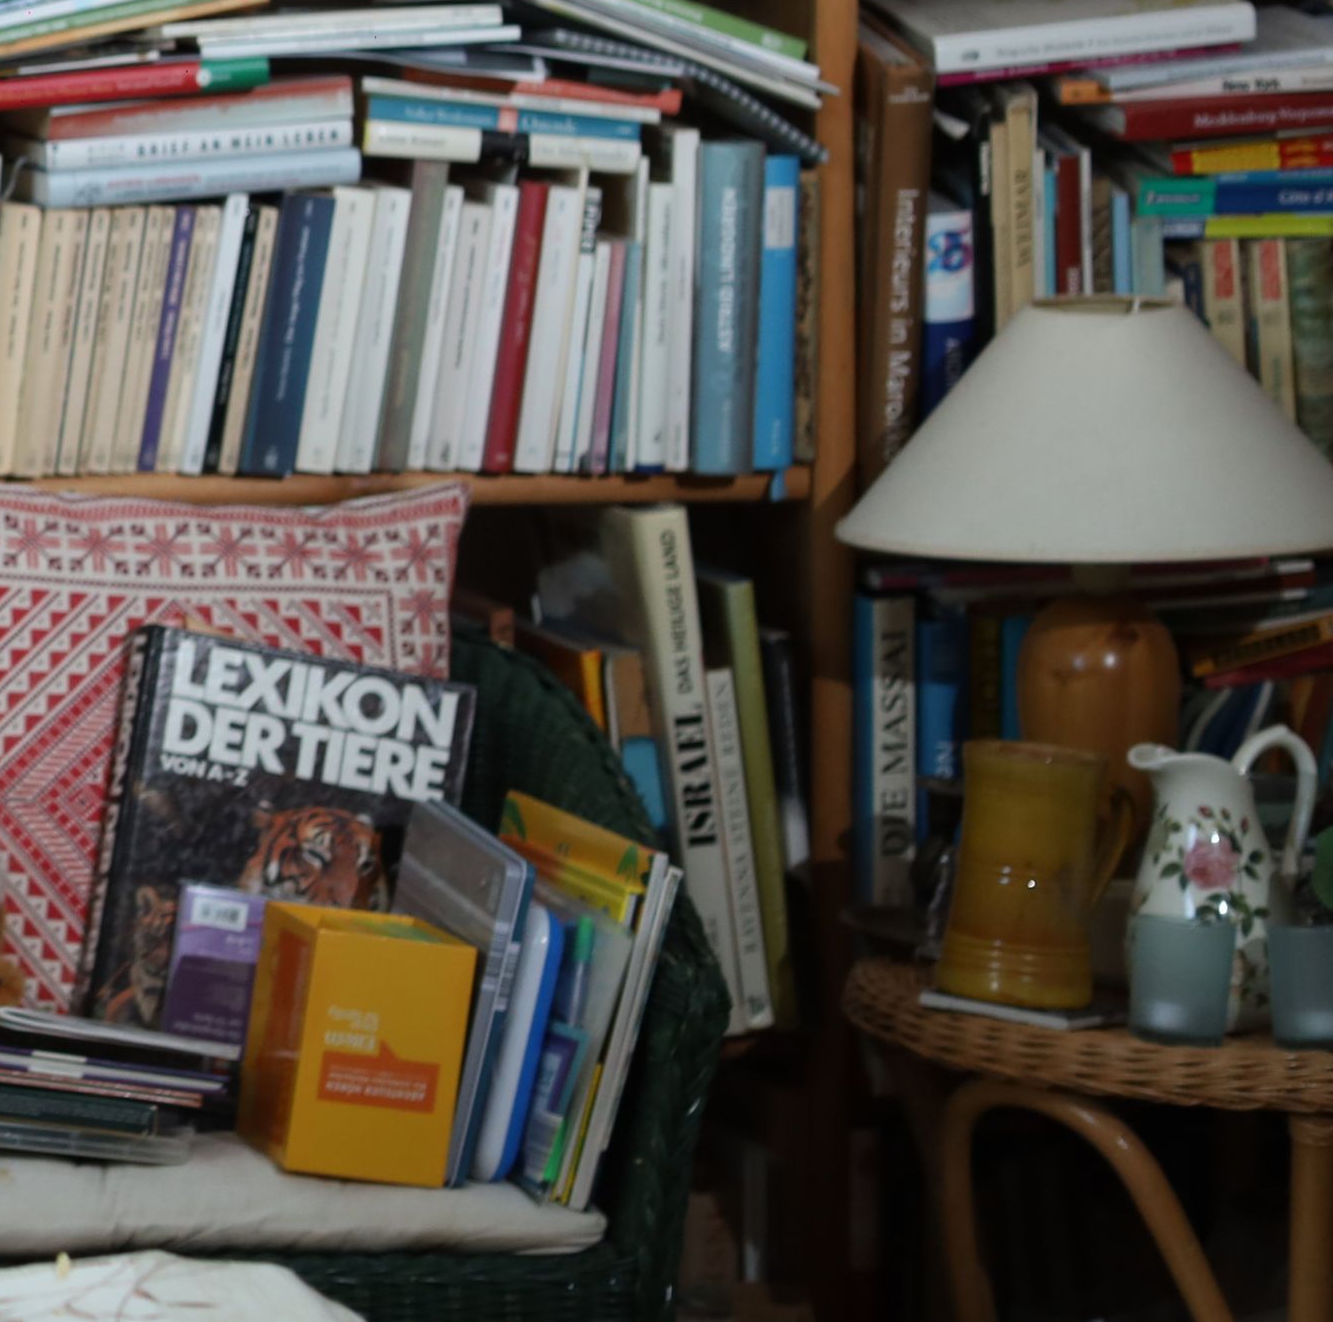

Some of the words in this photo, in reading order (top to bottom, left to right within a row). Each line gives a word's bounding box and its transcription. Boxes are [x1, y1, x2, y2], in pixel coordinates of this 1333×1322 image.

[136, 141, 192, 160] BRIEF
[199, 138, 221, 155] AN
[231, 133, 275, 152] MEIN
[282, 127, 340, 148] LEBEN
[720, 187, 738, 282] LINDGREN
[891, 189, 920, 313] Interieurs
[717, 286, 735, 354] ASTRID
[890, 318, 916, 345] in
[884, 350, 912, 459] Maro
[659, 529, 680, 581] LAND
[667, 585, 693, 654] HEILIGE
[171, 638, 461, 747] LEXIKON
[677, 656, 696, 693] DAS
[878, 626, 913, 793] MASSAI
[160, 753, 206, 779] VON
[165, 702, 285, 776] DER
[291, 722, 450, 802] TIERE
[672, 703, 719, 848] ISRAEL
